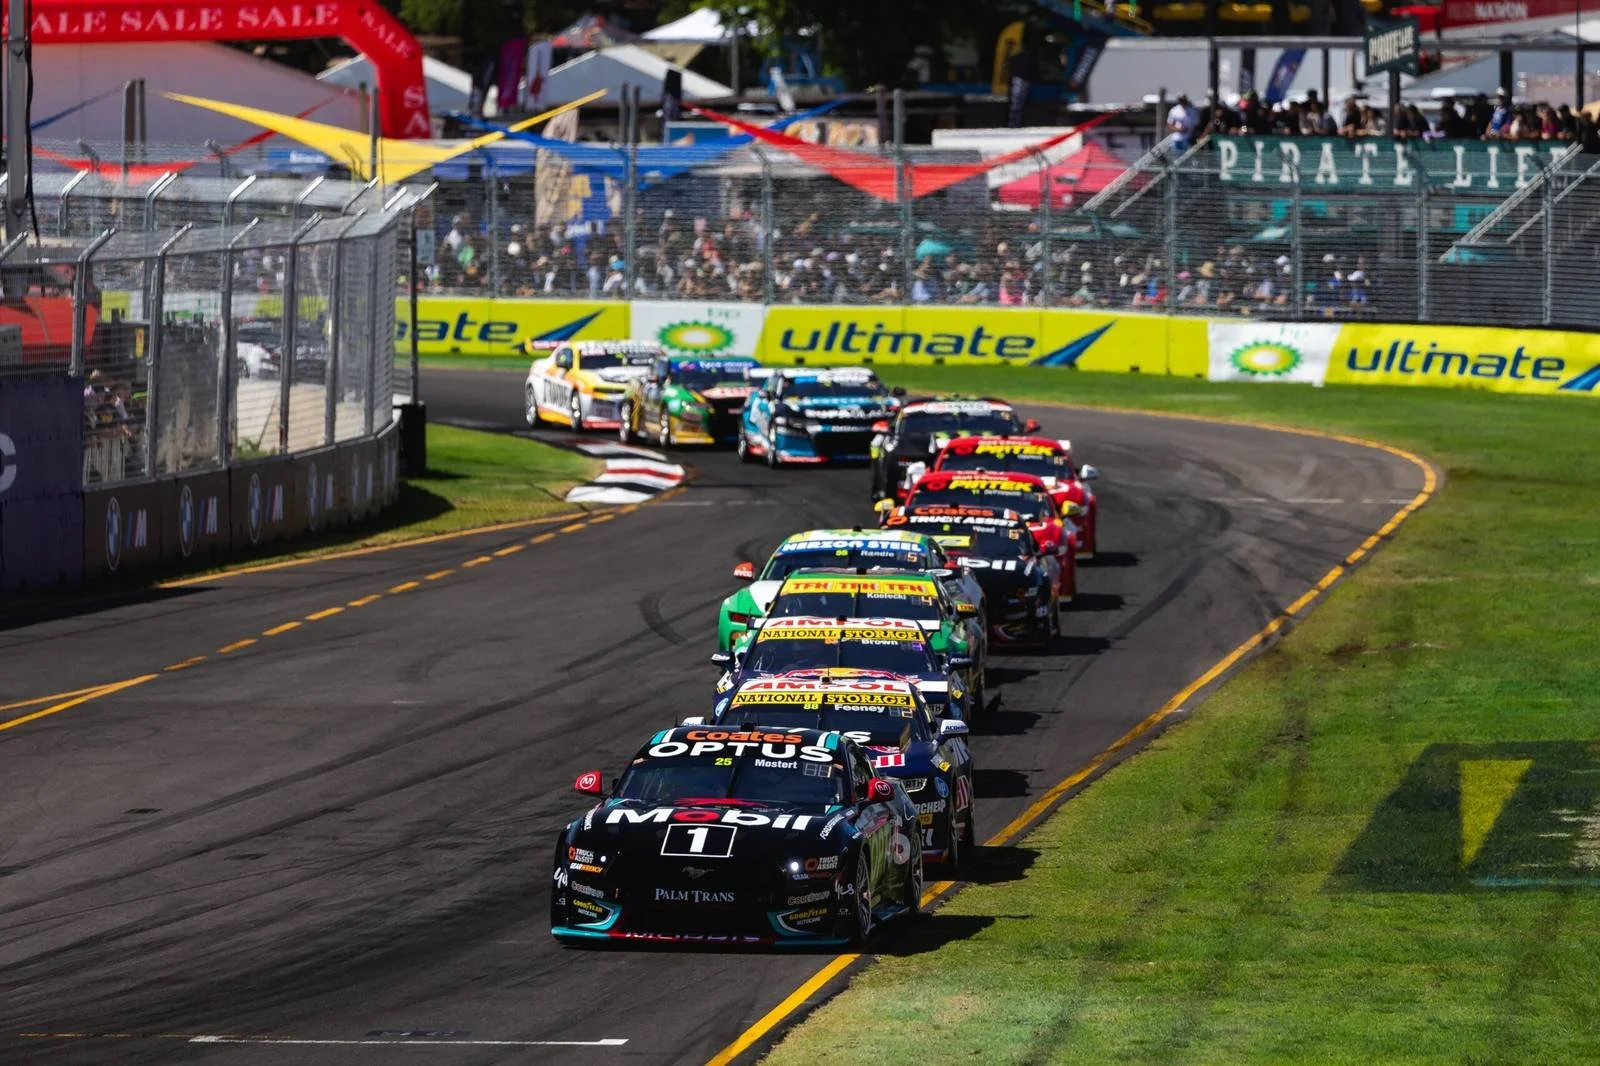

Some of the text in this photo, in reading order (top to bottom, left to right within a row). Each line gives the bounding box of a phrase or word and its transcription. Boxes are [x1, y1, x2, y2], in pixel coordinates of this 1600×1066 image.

[120, 9, 223, 32] SALE
[237, 4, 339, 29] SALE
[362, 11, 413, 60] SALE
[1218, 140, 1413, 186] PIRATE
[780, 321, 1036, 358] ultimate
[1347, 340, 1566, 380] ultimate
[868, 541, 922, 552] STEEL
[770, 618, 915, 629] AMPOL
[762, 629, 917, 640] NATIONAL STORAGE
[745, 681, 906, 693] AMPOL
[738, 693, 907, 705] NATIONAL STORAGE
[834, 703, 886, 713] Feeney
[686, 730, 802, 744] Coates
[648, 741, 834, 763] OPTUS
[714, 757, 733, 766] 25
[754, 759, 798, 769] Mostert
[605, 808, 813, 831] Mobil
[686, 827, 710, 853] 1
[655, 888, 735, 903] PALM TRANS
